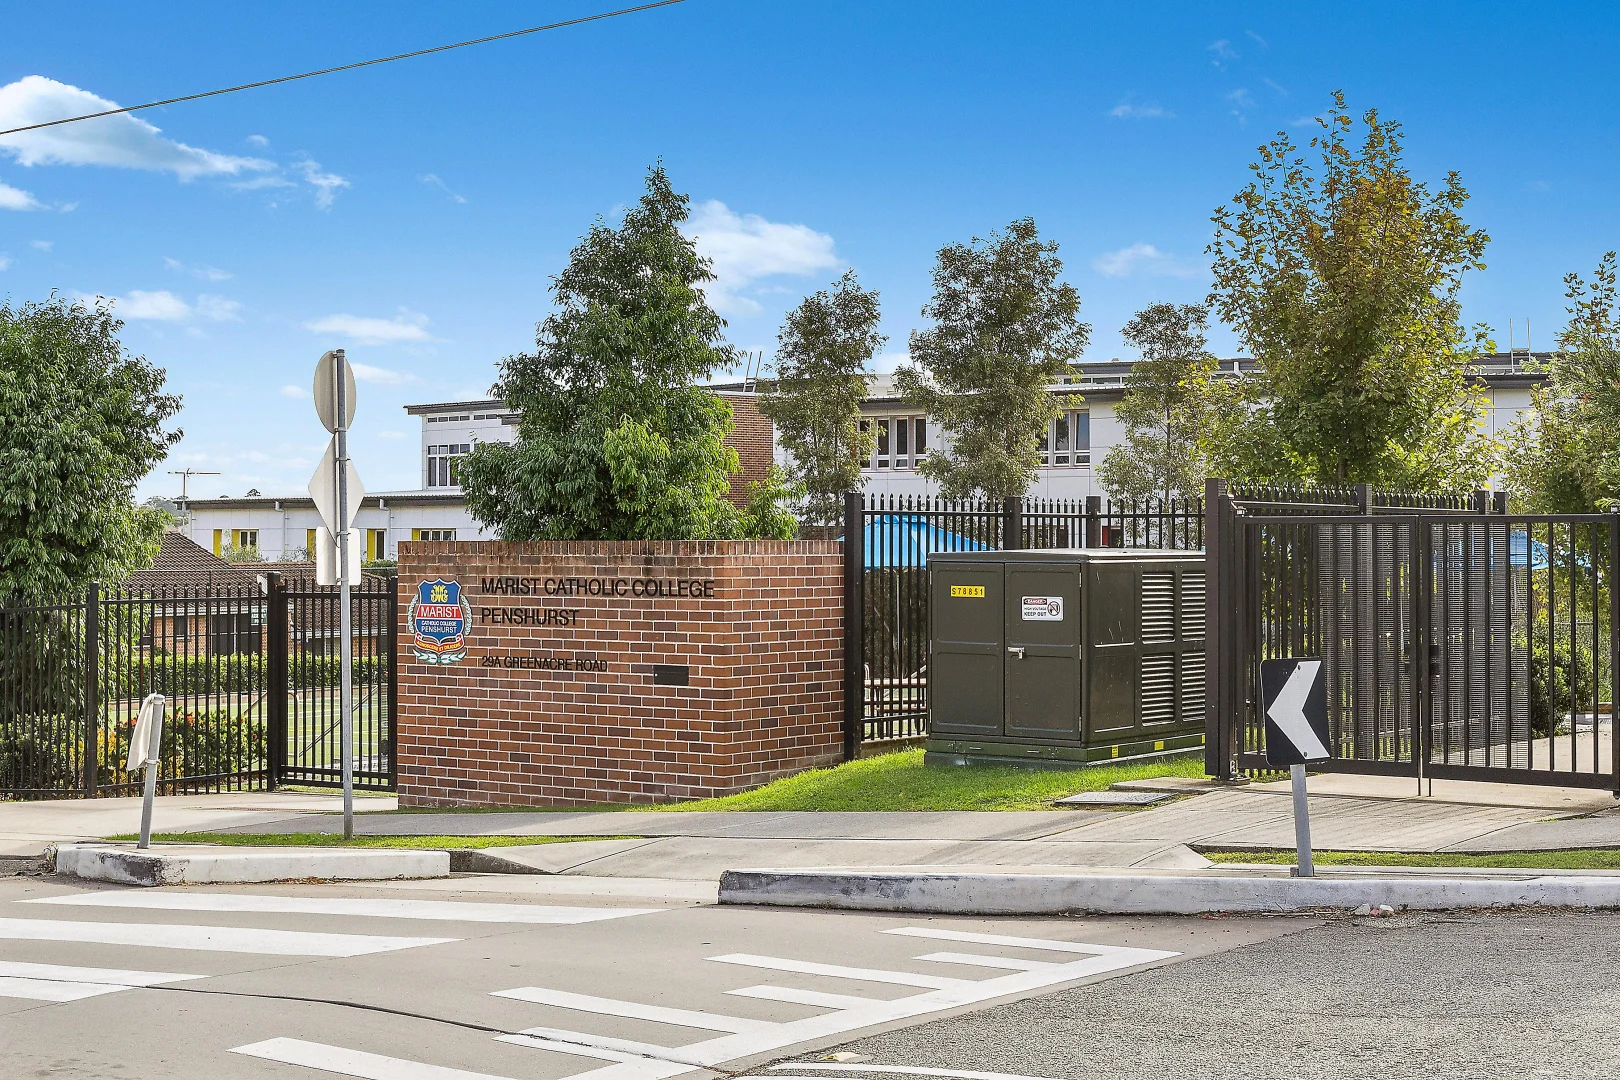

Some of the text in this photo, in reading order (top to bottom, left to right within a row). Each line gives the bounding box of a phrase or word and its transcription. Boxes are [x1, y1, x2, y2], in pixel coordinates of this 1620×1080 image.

[481, 577, 715, 598] MARIST CATHOLIC COLLEGE
[951, 587, 983, 596] S78851
[420, 606, 458, 618] MARIST
[481, 607, 580, 626] PENSHURST
[481, 656, 608, 672] 29A GREENACRE ROAD
